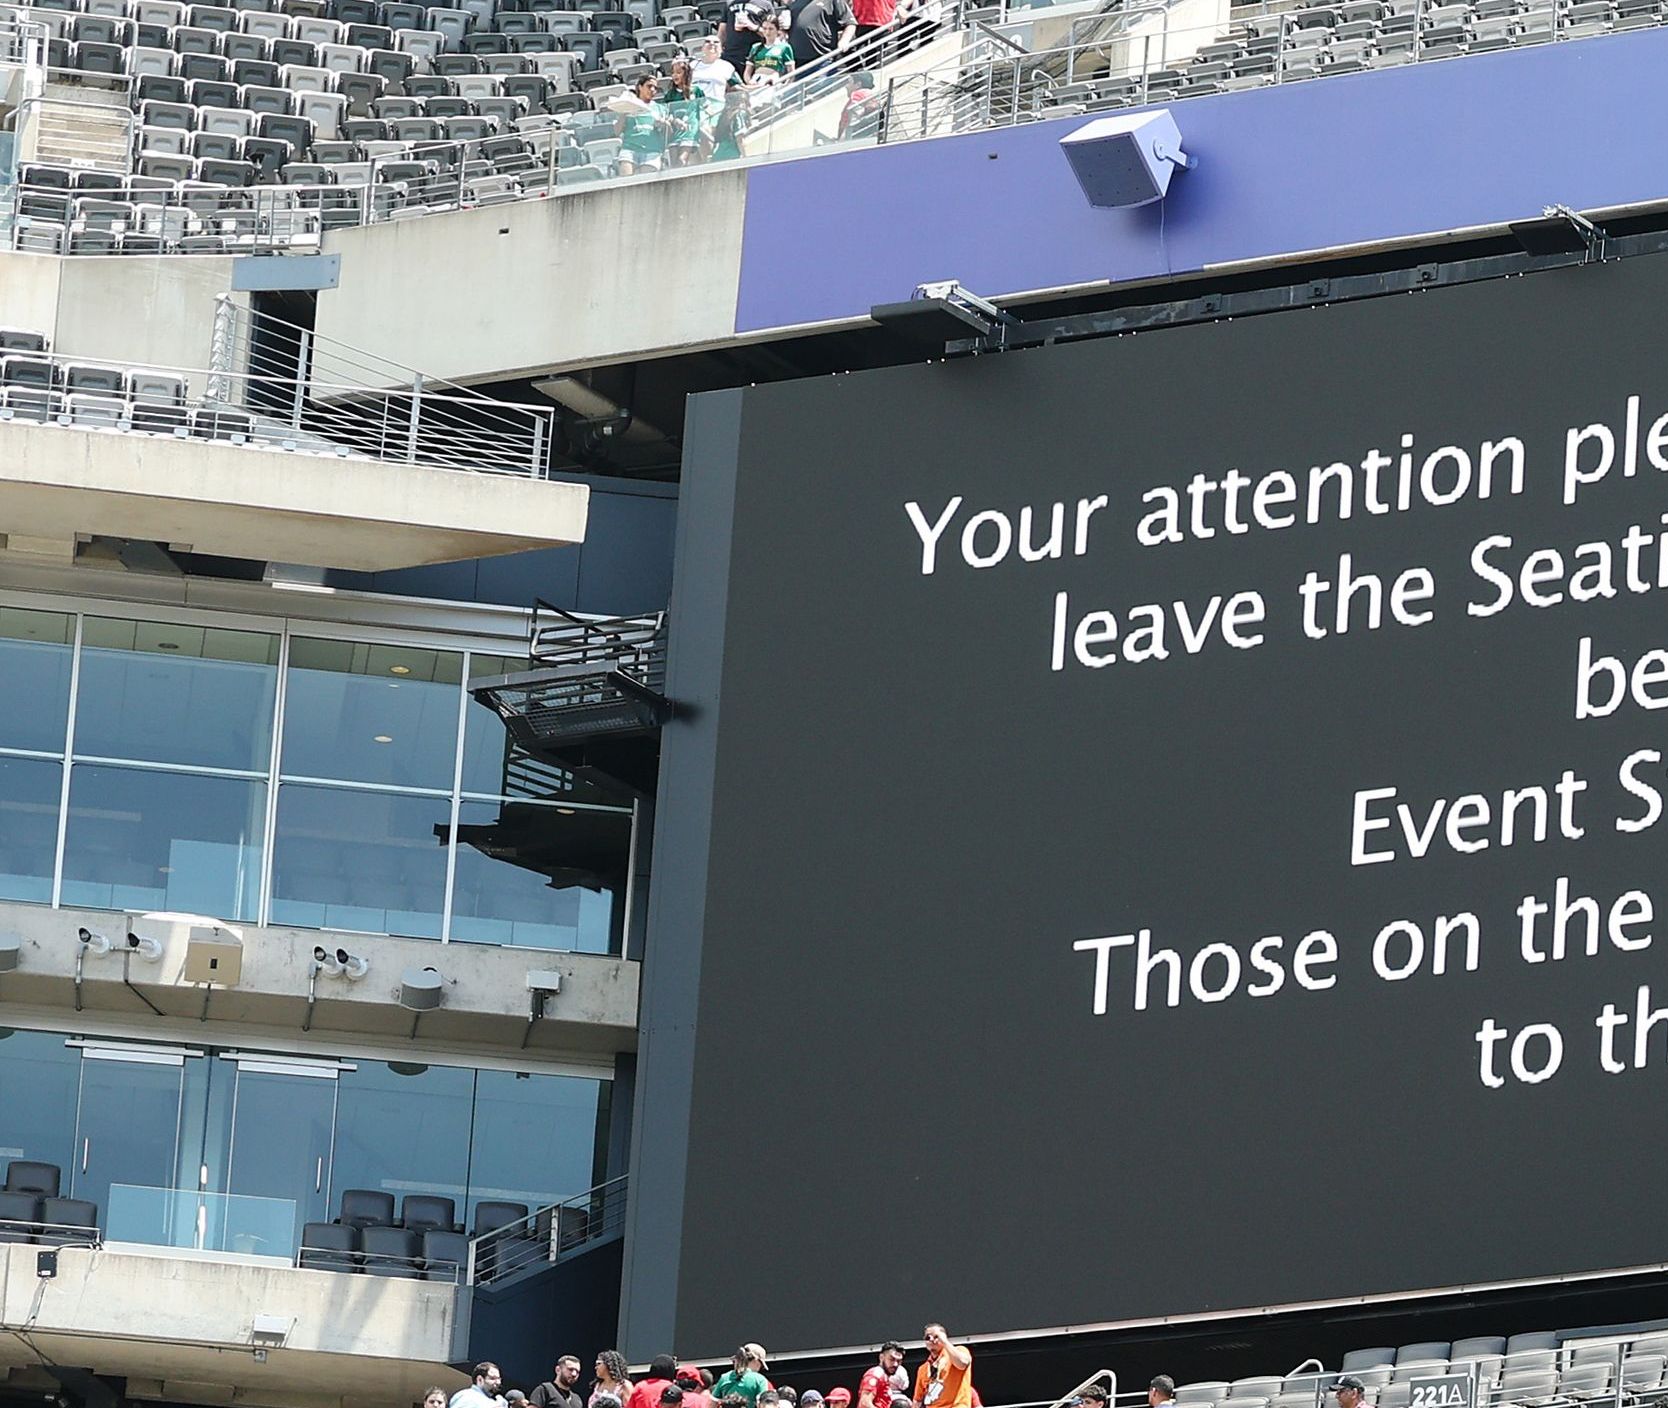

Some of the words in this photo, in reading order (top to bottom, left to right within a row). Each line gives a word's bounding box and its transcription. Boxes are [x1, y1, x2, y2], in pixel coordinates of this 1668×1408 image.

[904, 494, 1109, 575] Your
[1136, 433, 1525, 546] attention
[1051, 591, 1266, 671] leave
[1298, 553, 1435, 640] the
[1351, 770, 1588, 866] Event
[1072, 928, 1338, 1015] Those
[1372, 911, 1480, 981] on
[1516, 876, 1654, 964] the
[1475, 1018, 1564, 1089] to
[1412, 1383, 1465, 1407] 221A
